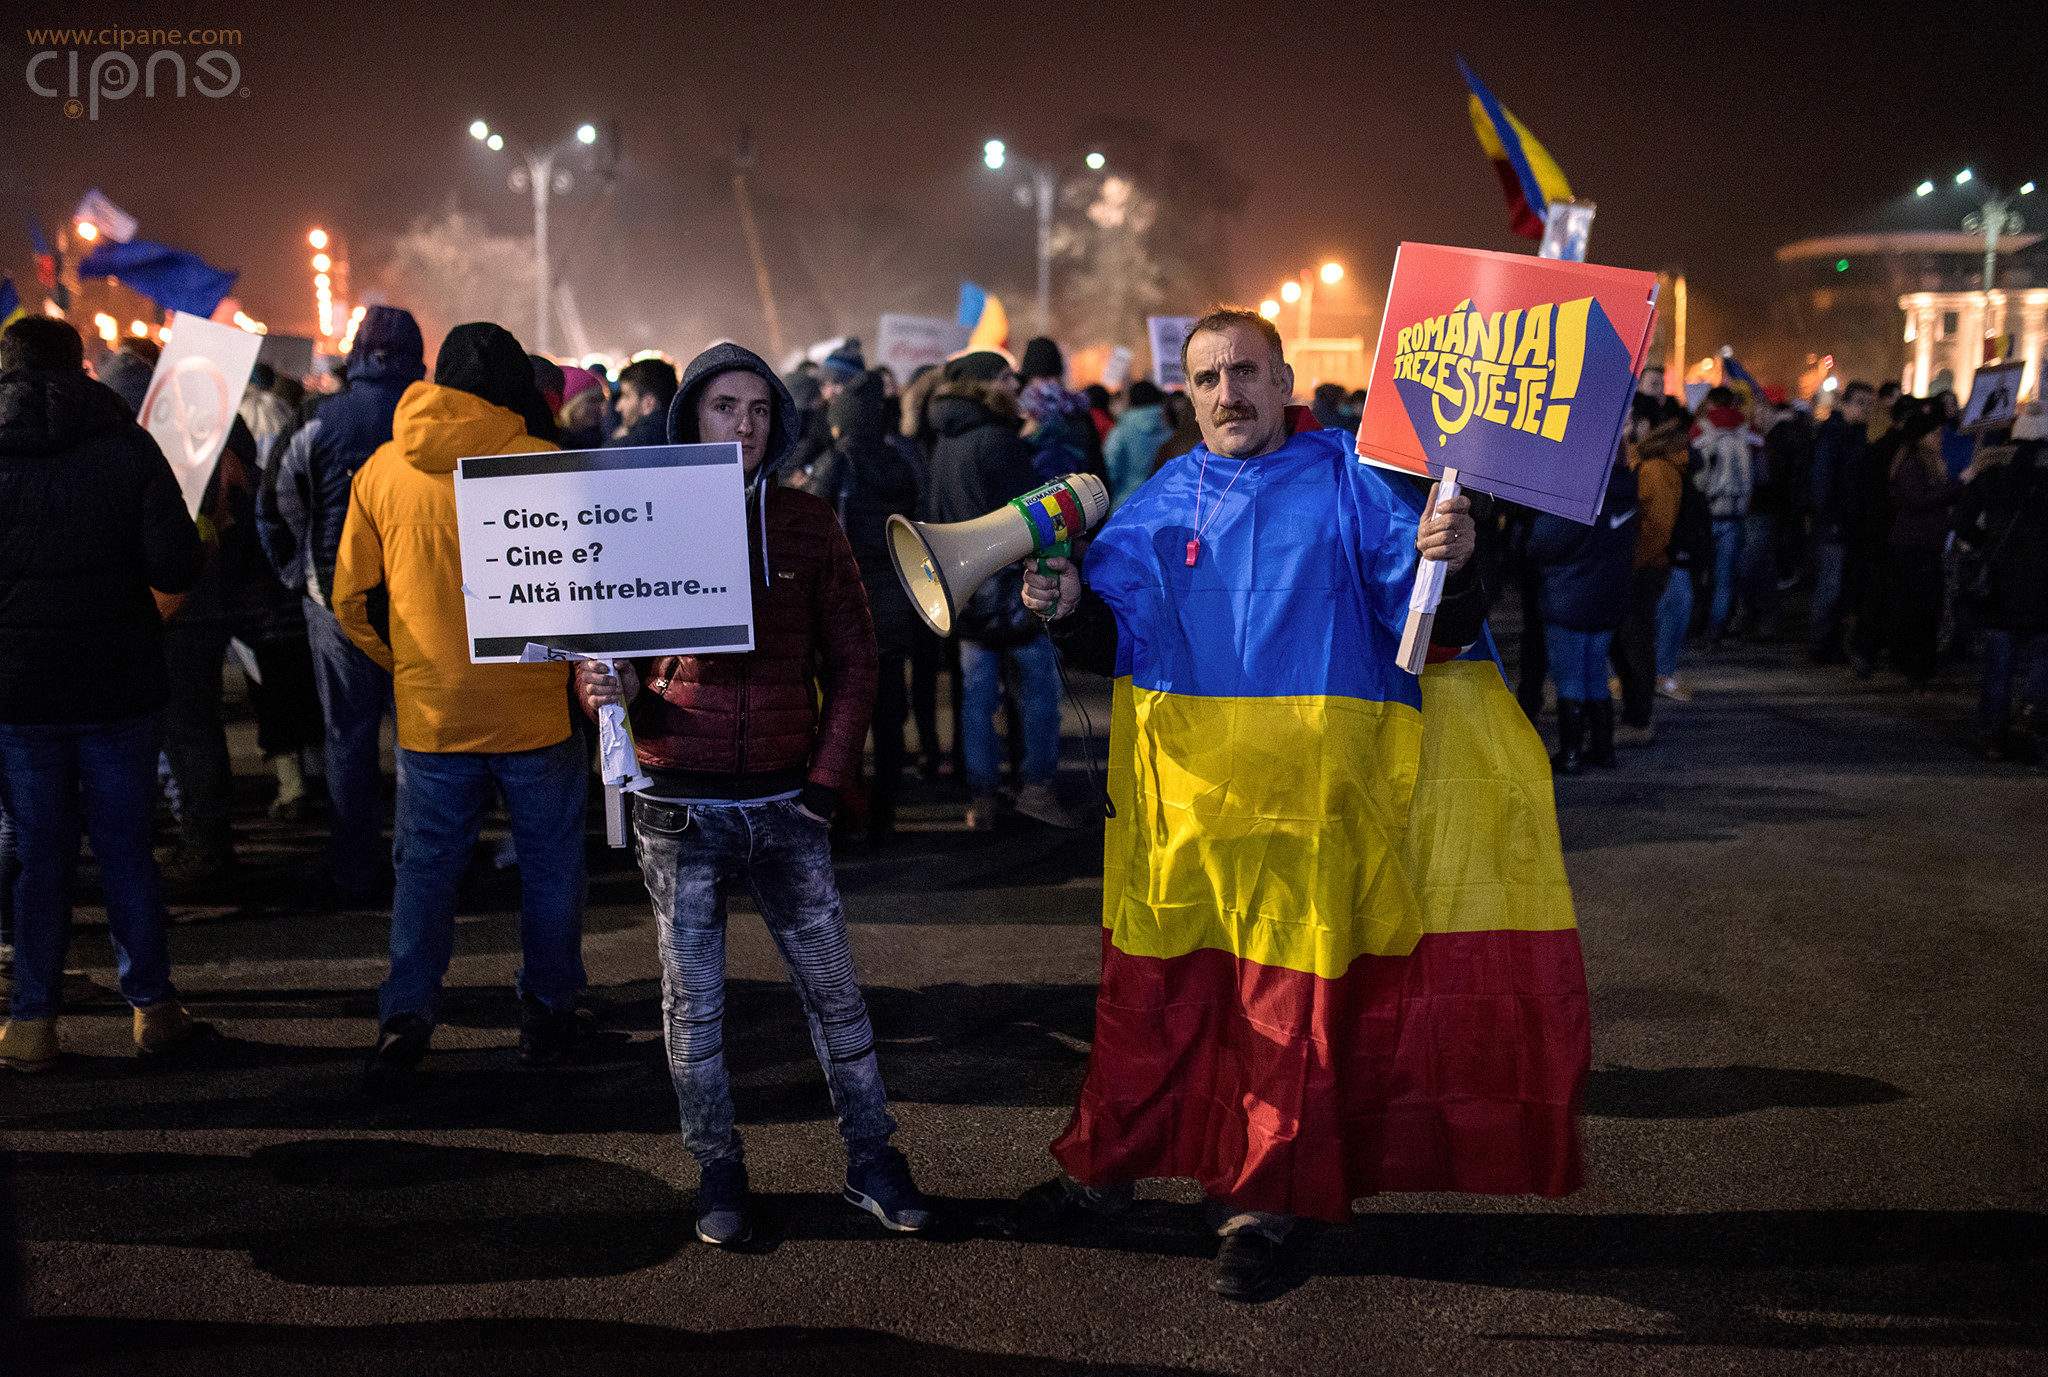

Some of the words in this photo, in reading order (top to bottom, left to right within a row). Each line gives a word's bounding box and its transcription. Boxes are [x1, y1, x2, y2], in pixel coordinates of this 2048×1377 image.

[1396, 298, 1555, 372] ROMÂNIA,
[1025, 485, 1063, 506] ROMANIA
[503, 509, 569, 531] Cioc,
[506, 546, 563, 567] Cine
[572, 542, 604, 564] e?
[508, 582, 561, 604] Altă
[568, 578, 727, 602] întrebare...
